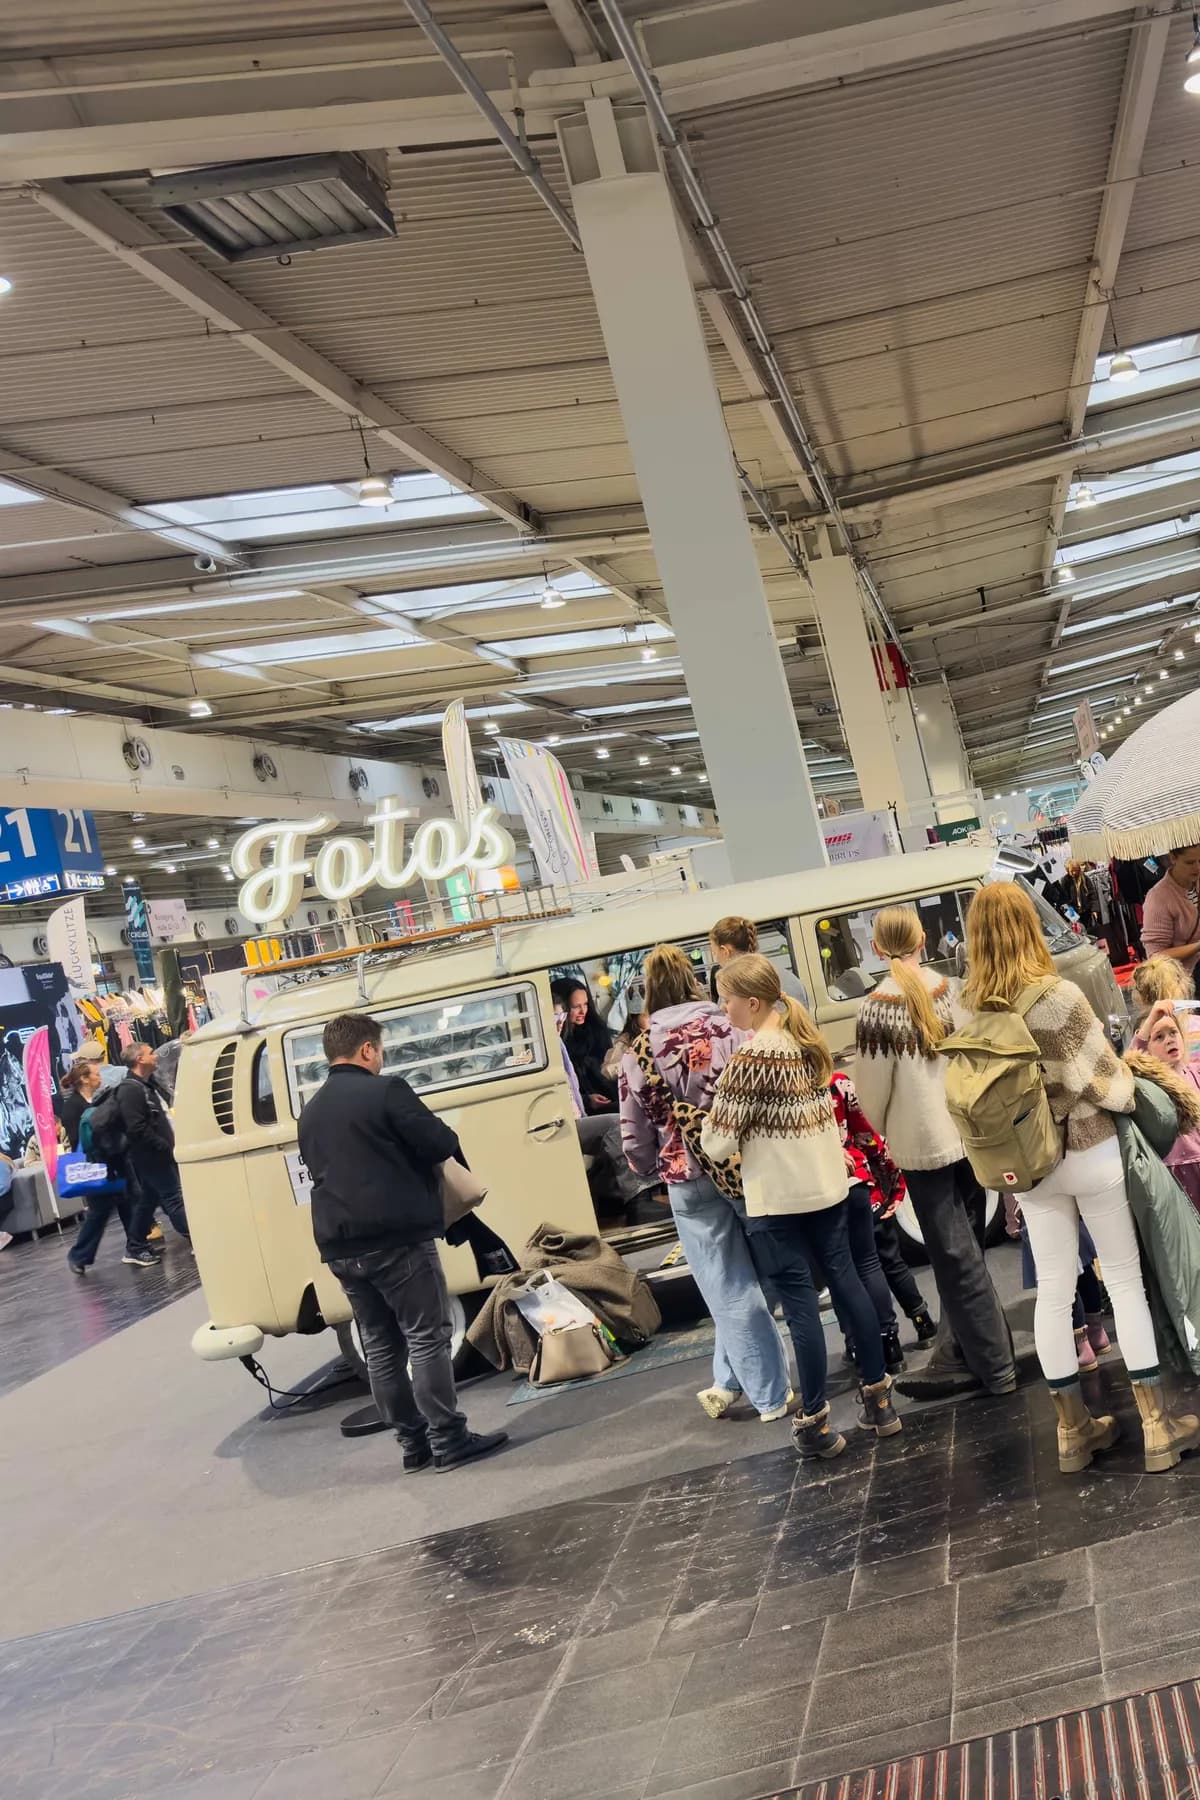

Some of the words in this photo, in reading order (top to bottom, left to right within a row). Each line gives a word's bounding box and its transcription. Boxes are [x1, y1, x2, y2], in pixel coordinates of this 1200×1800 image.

[0, 808, 37, 863] 1
[57, 809, 92, 854] 21
[231, 794, 516, 923] Fotos
[952, 827, 968, 836] AOK
[64, 907, 83, 981] LUCKYLITZE
